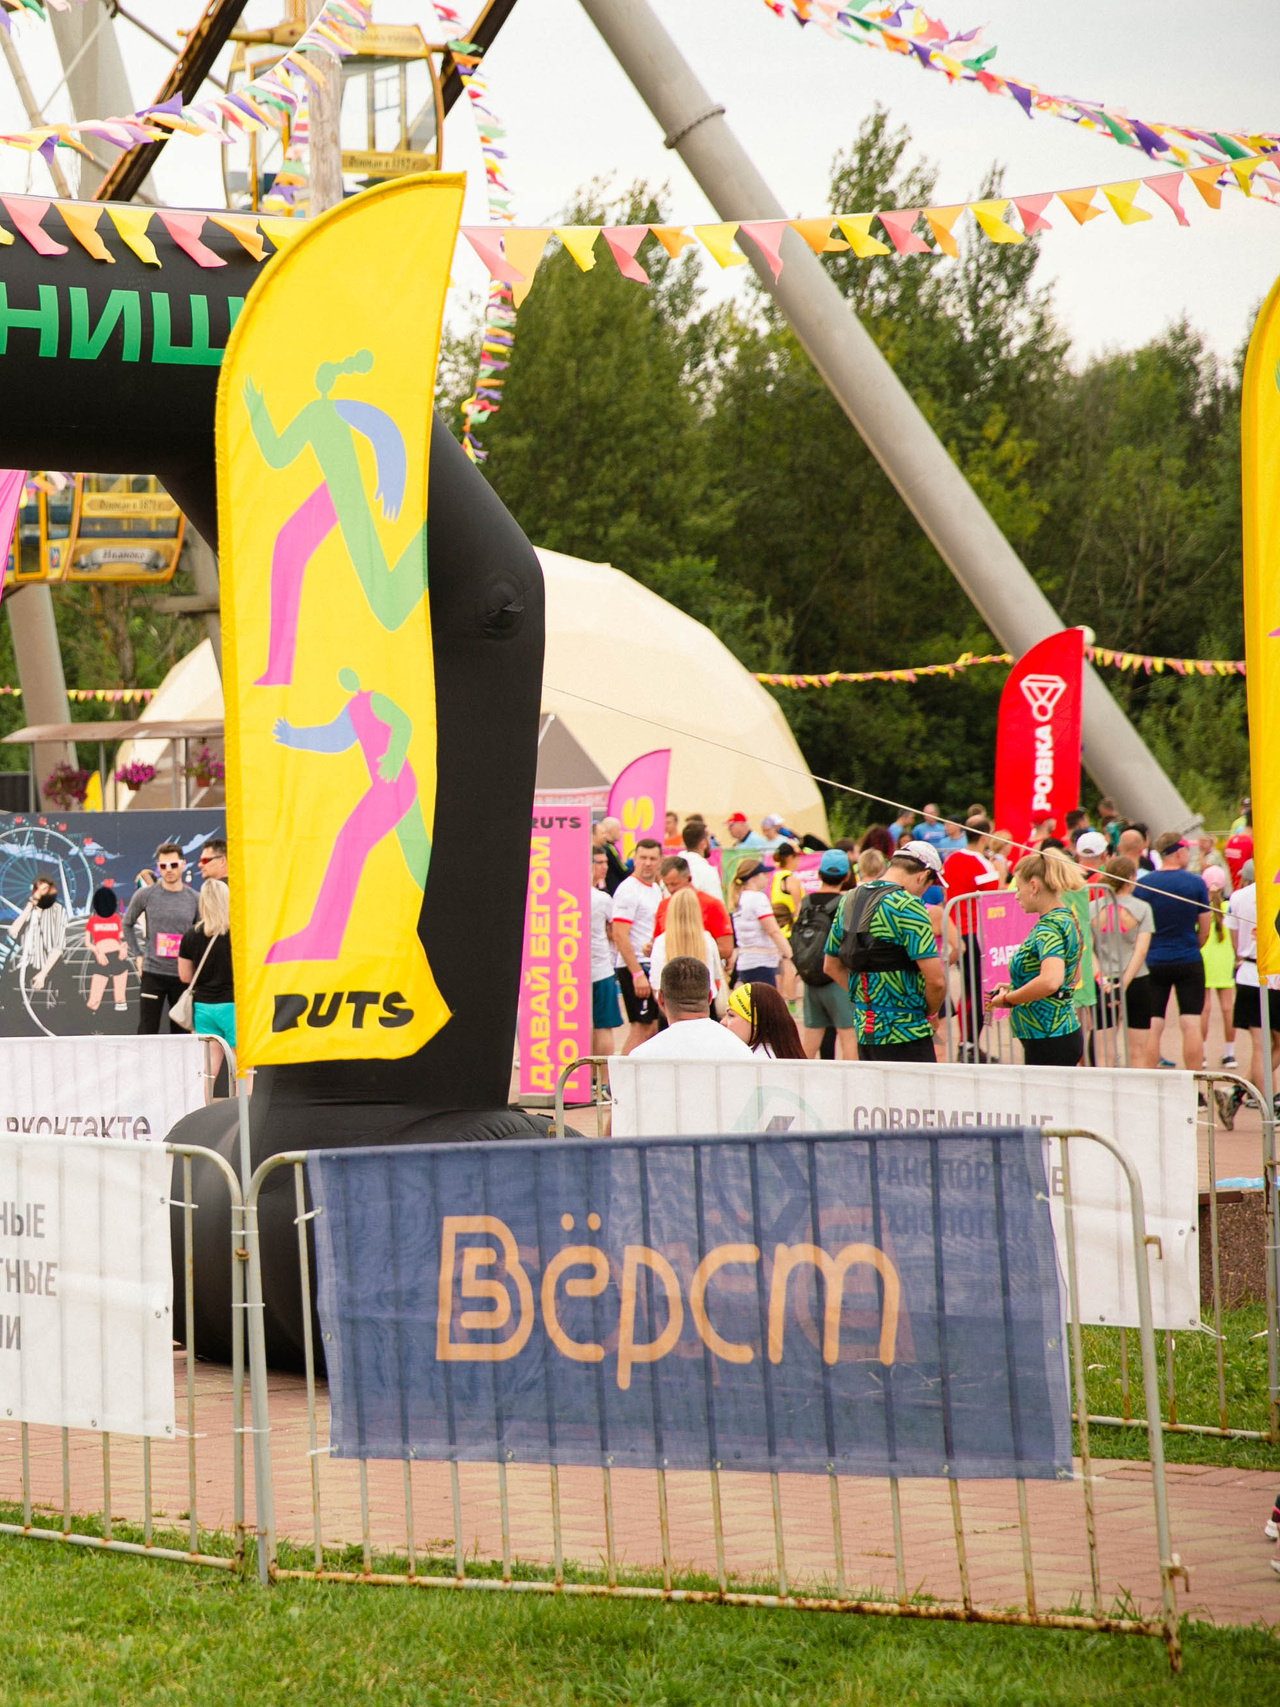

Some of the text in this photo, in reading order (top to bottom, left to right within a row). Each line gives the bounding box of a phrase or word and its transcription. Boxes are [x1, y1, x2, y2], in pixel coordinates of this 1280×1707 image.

[1031, 724, 1054, 811] РОВКА
[524, 836, 554, 1090] ДАВАЙ БЕГОМ
[557, 888, 582, 1090] ПО ГОРОДУ
